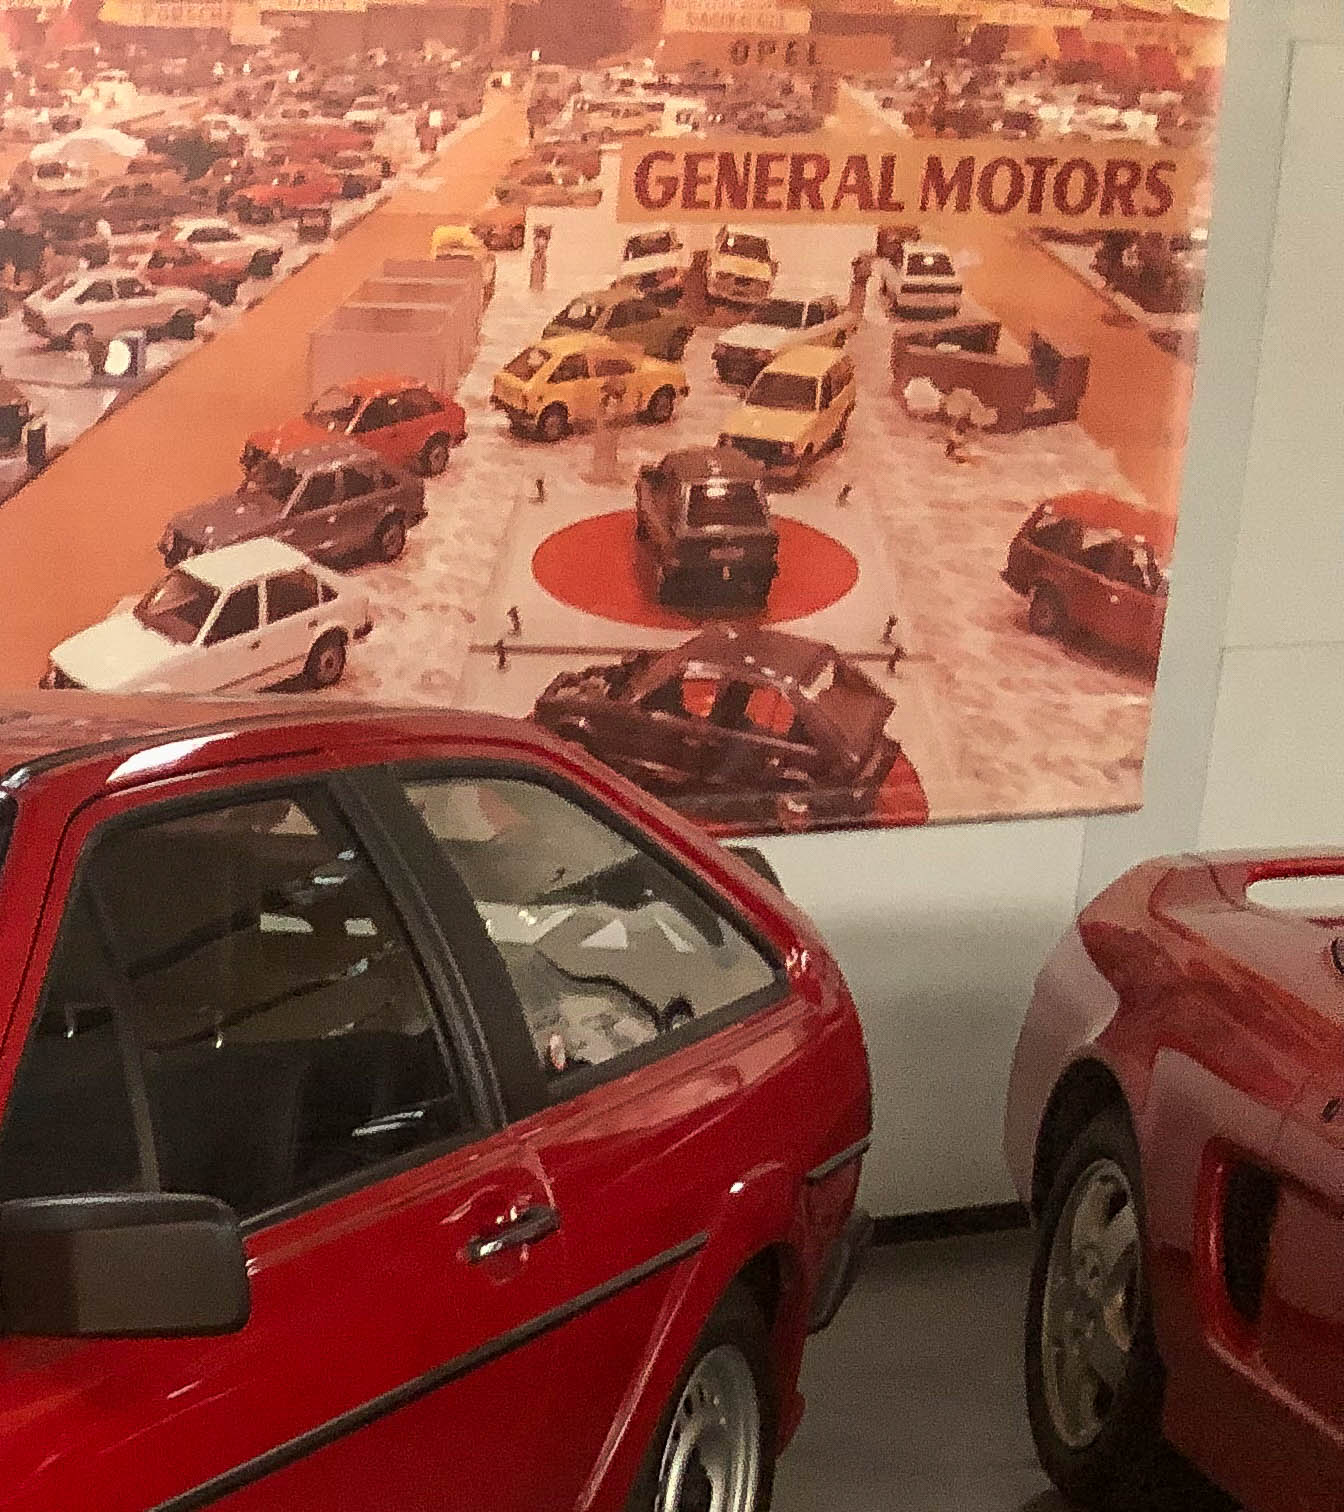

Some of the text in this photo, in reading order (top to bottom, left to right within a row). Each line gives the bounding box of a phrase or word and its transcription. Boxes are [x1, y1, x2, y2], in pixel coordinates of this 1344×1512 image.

[728, 38, 820, 66] OPEL
[632, 149, 1178, 219] GENERAL MOTORS
